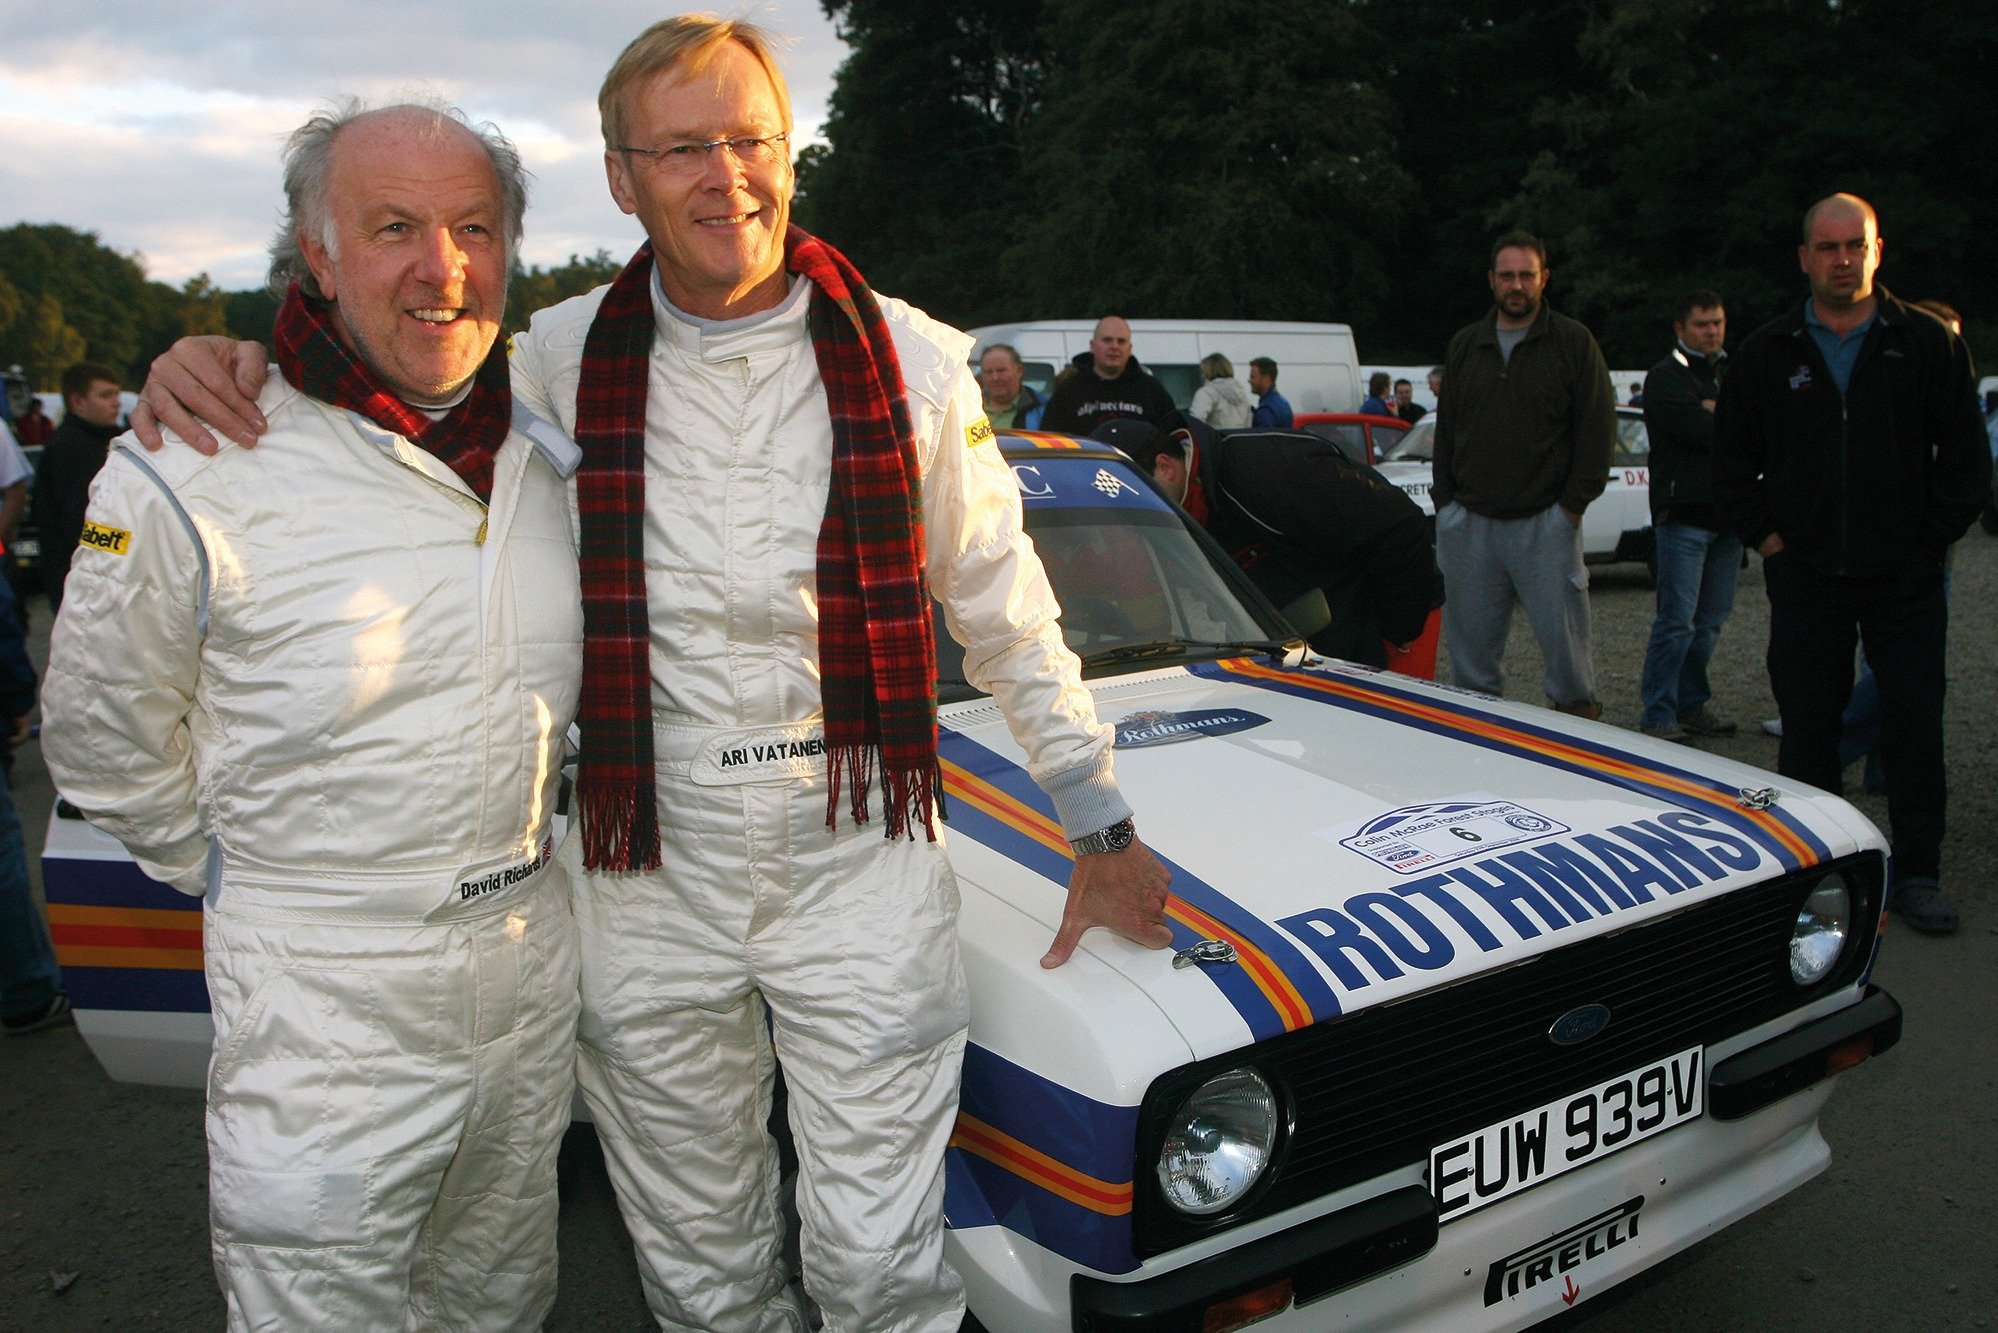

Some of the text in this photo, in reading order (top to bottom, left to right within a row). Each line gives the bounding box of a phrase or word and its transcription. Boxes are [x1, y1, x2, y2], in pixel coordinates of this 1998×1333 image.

[83, 524, 121, 550] abelt
[1118, 714, 1246, 744] Rothmans
[721, 749, 749, 768] ARI
[1354, 835, 1391, 848] Colin
[1389, 821, 1437, 838] McRae
[1433, 812, 1474, 826] Forest
[1448, 827, 1482, 842] 6
[461, 873, 501, 900] David
[1274, 811, 1762, 992] ROTHMANS
[1434, 1051, 1700, 1216] EUW 939V
[1483, 1194, 1646, 1308] PIRELLI
